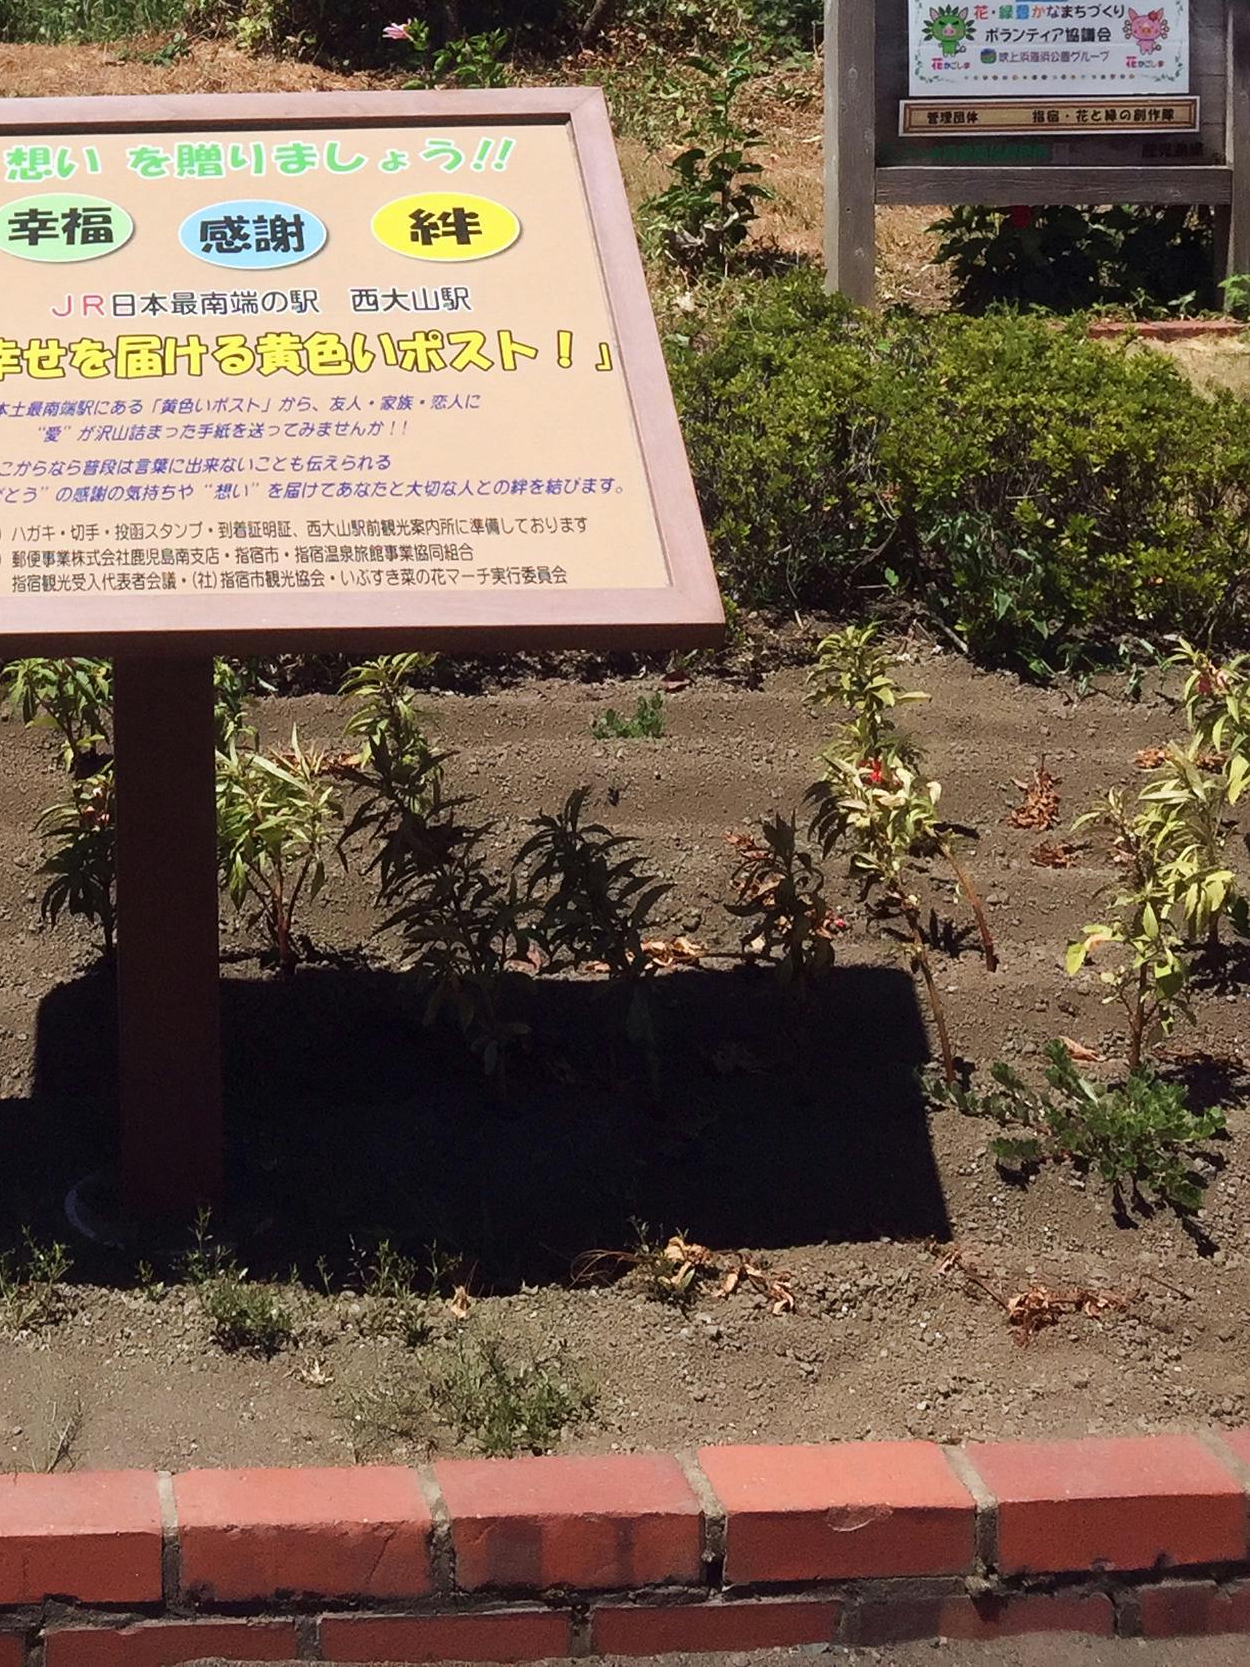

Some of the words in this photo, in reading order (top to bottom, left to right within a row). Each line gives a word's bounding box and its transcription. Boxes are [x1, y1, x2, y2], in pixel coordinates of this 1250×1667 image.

[984, 27, 1112, 43] ボランティア協議会
[926, 111, 979, 124] 管理団体
[5, 146, 101, 181] 想い
[7, 207, 115, 246] 幸福
[199, 212, 306, 254] 感謝
[408, 207, 483, 246] 絆
[349, 285, 473, 312] 西大山駅
